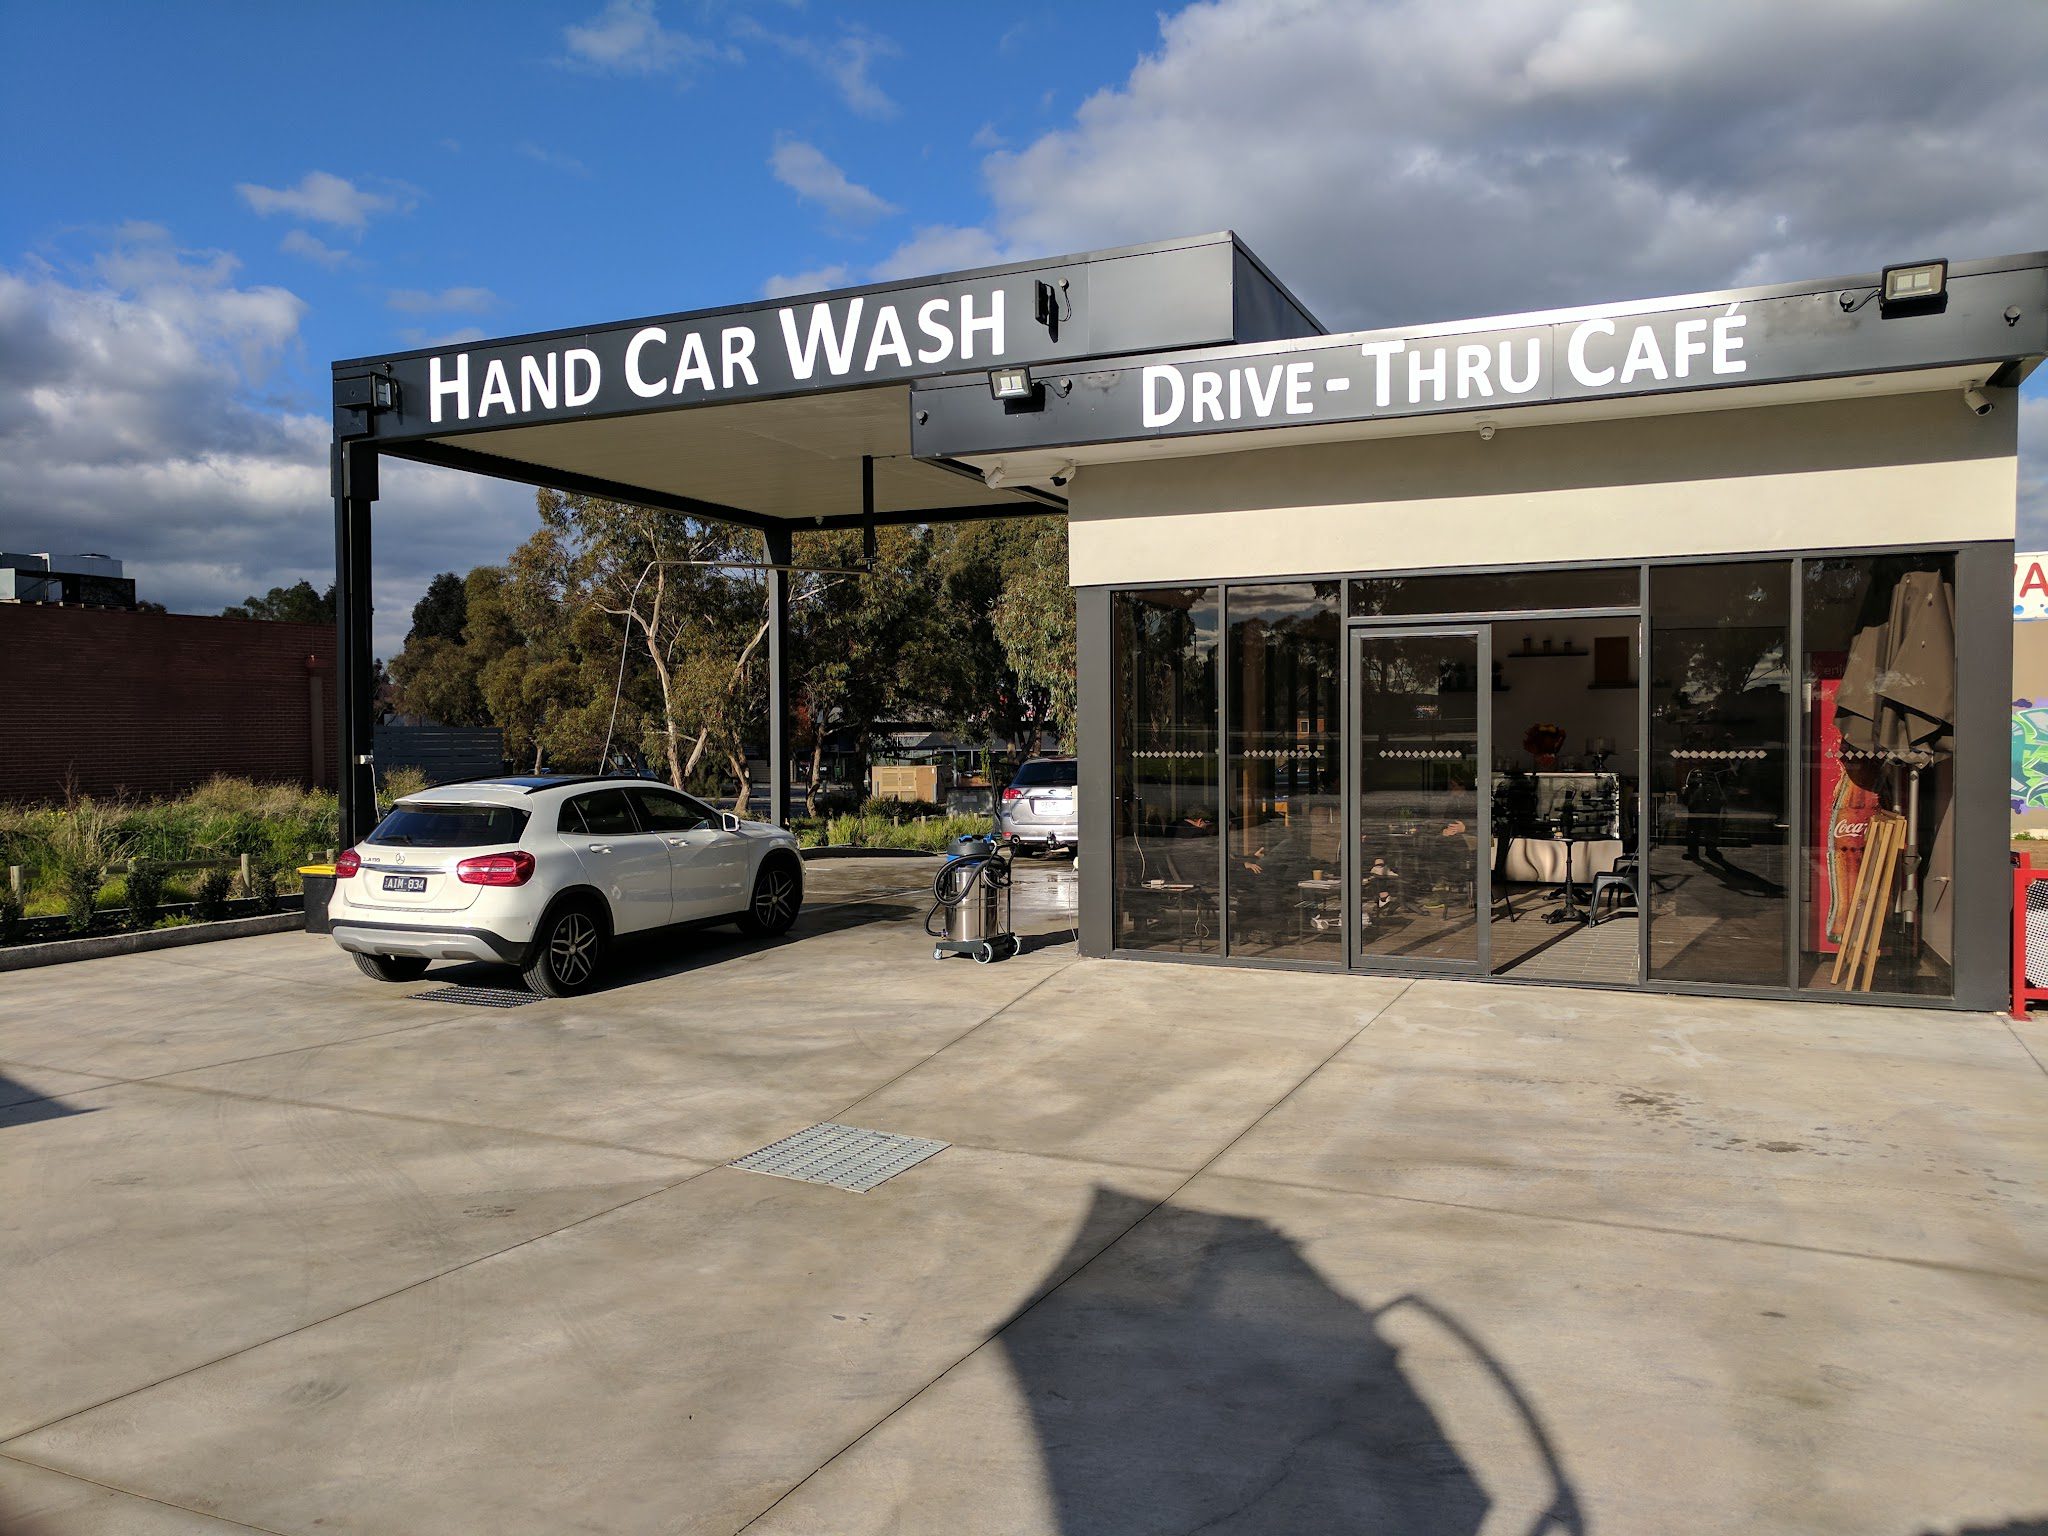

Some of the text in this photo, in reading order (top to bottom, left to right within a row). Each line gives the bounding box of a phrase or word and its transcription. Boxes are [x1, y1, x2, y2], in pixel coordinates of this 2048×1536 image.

[428, 289, 1006, 423] HAND CAR WASH
[1141, 361, 1314, 428] DRIVE
[1361, 337, 1541, 407] THRU
[1567, 303, 1748, 387] CAFÉ
